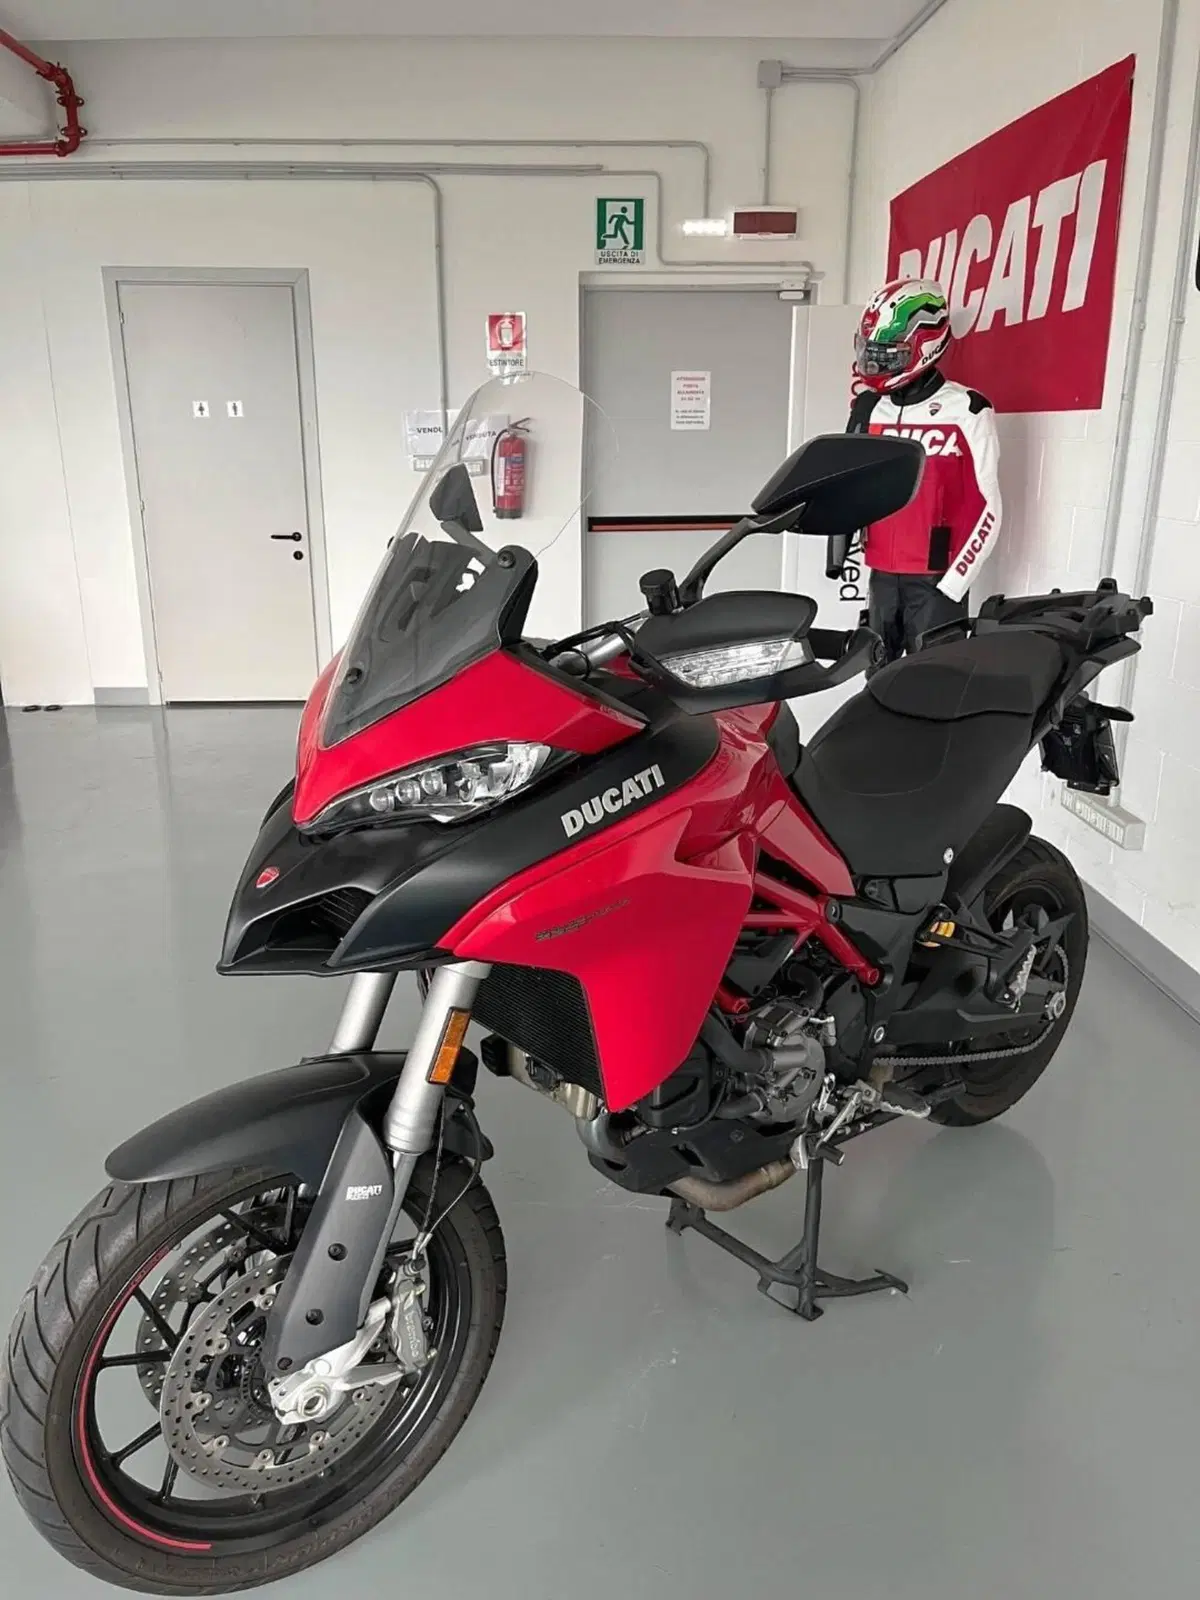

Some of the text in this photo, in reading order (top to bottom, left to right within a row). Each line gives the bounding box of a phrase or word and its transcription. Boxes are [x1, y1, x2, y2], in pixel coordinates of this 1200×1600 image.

[600, 250, 639, 258] USCITA DI
[489, 358, 525, 367] ESTINTORE
[955, 511, 996, 577] DUCATI
[560, 763, 666, 838] DUCATI
